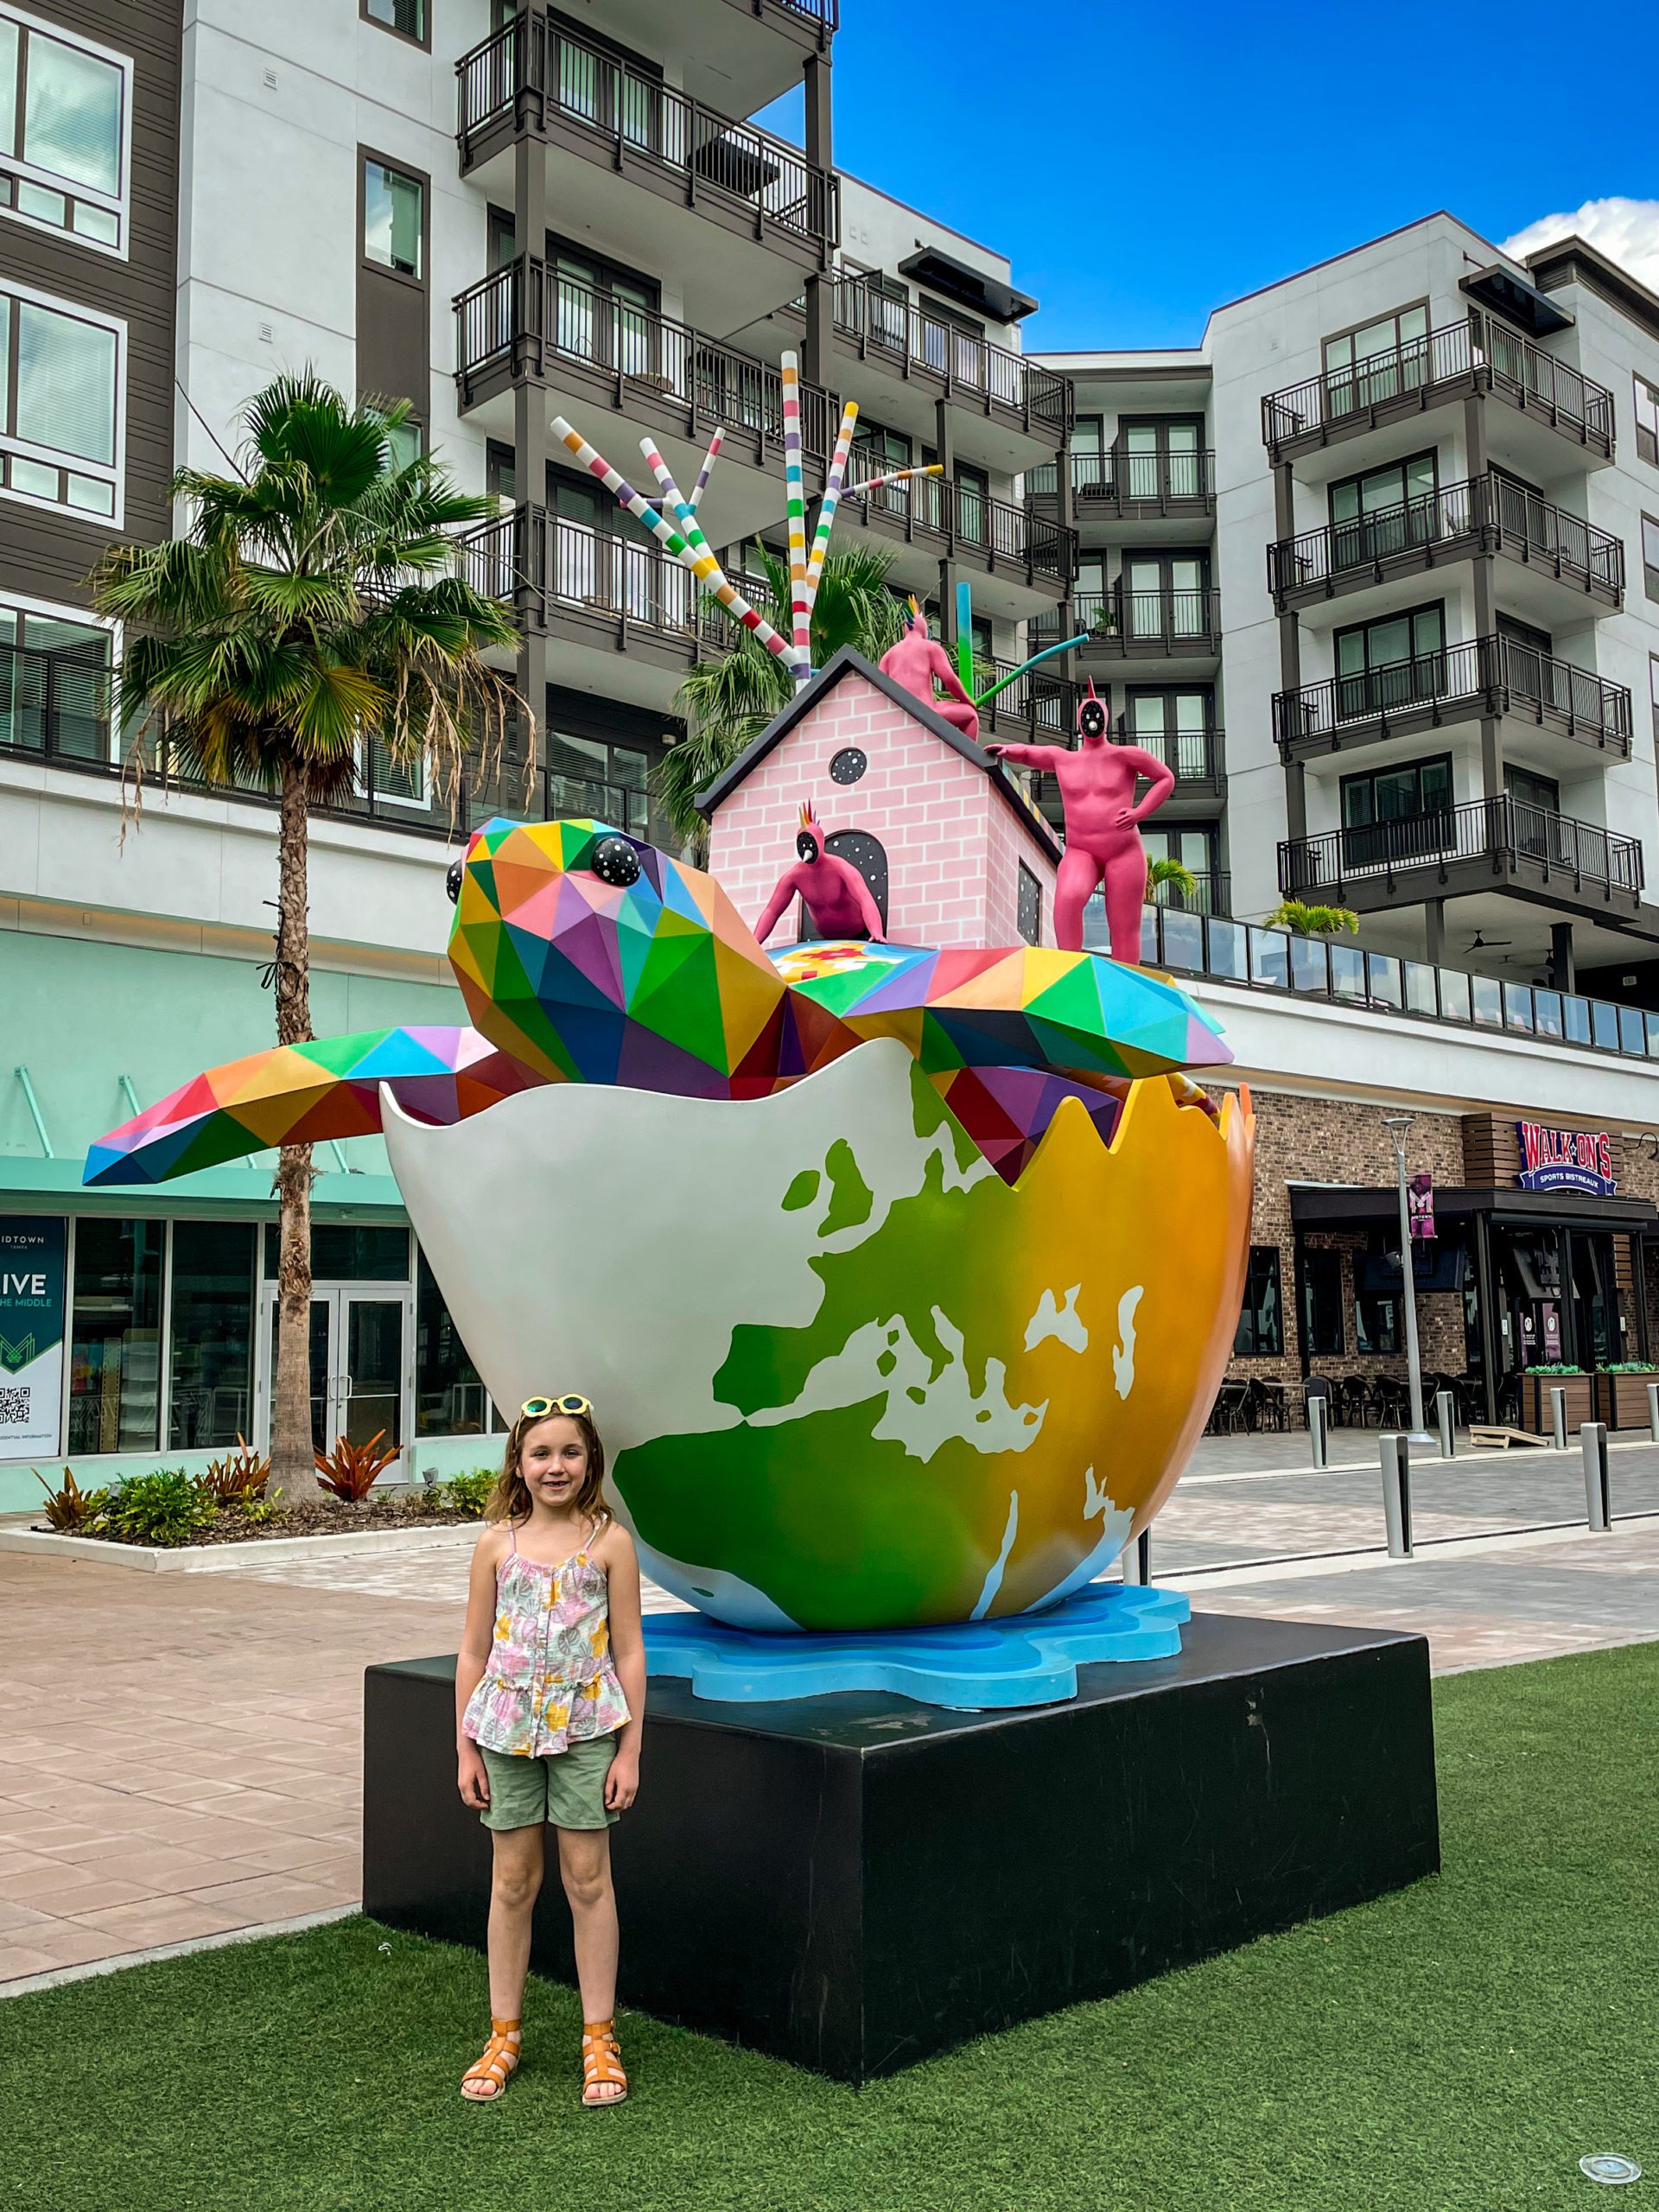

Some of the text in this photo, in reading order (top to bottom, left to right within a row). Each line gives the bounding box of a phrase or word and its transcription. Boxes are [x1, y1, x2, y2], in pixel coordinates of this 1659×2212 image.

[1540, 1173, 1599, 1188] SPORTS BISTREAUX
[0, 1274, 46, 1294] IVE
